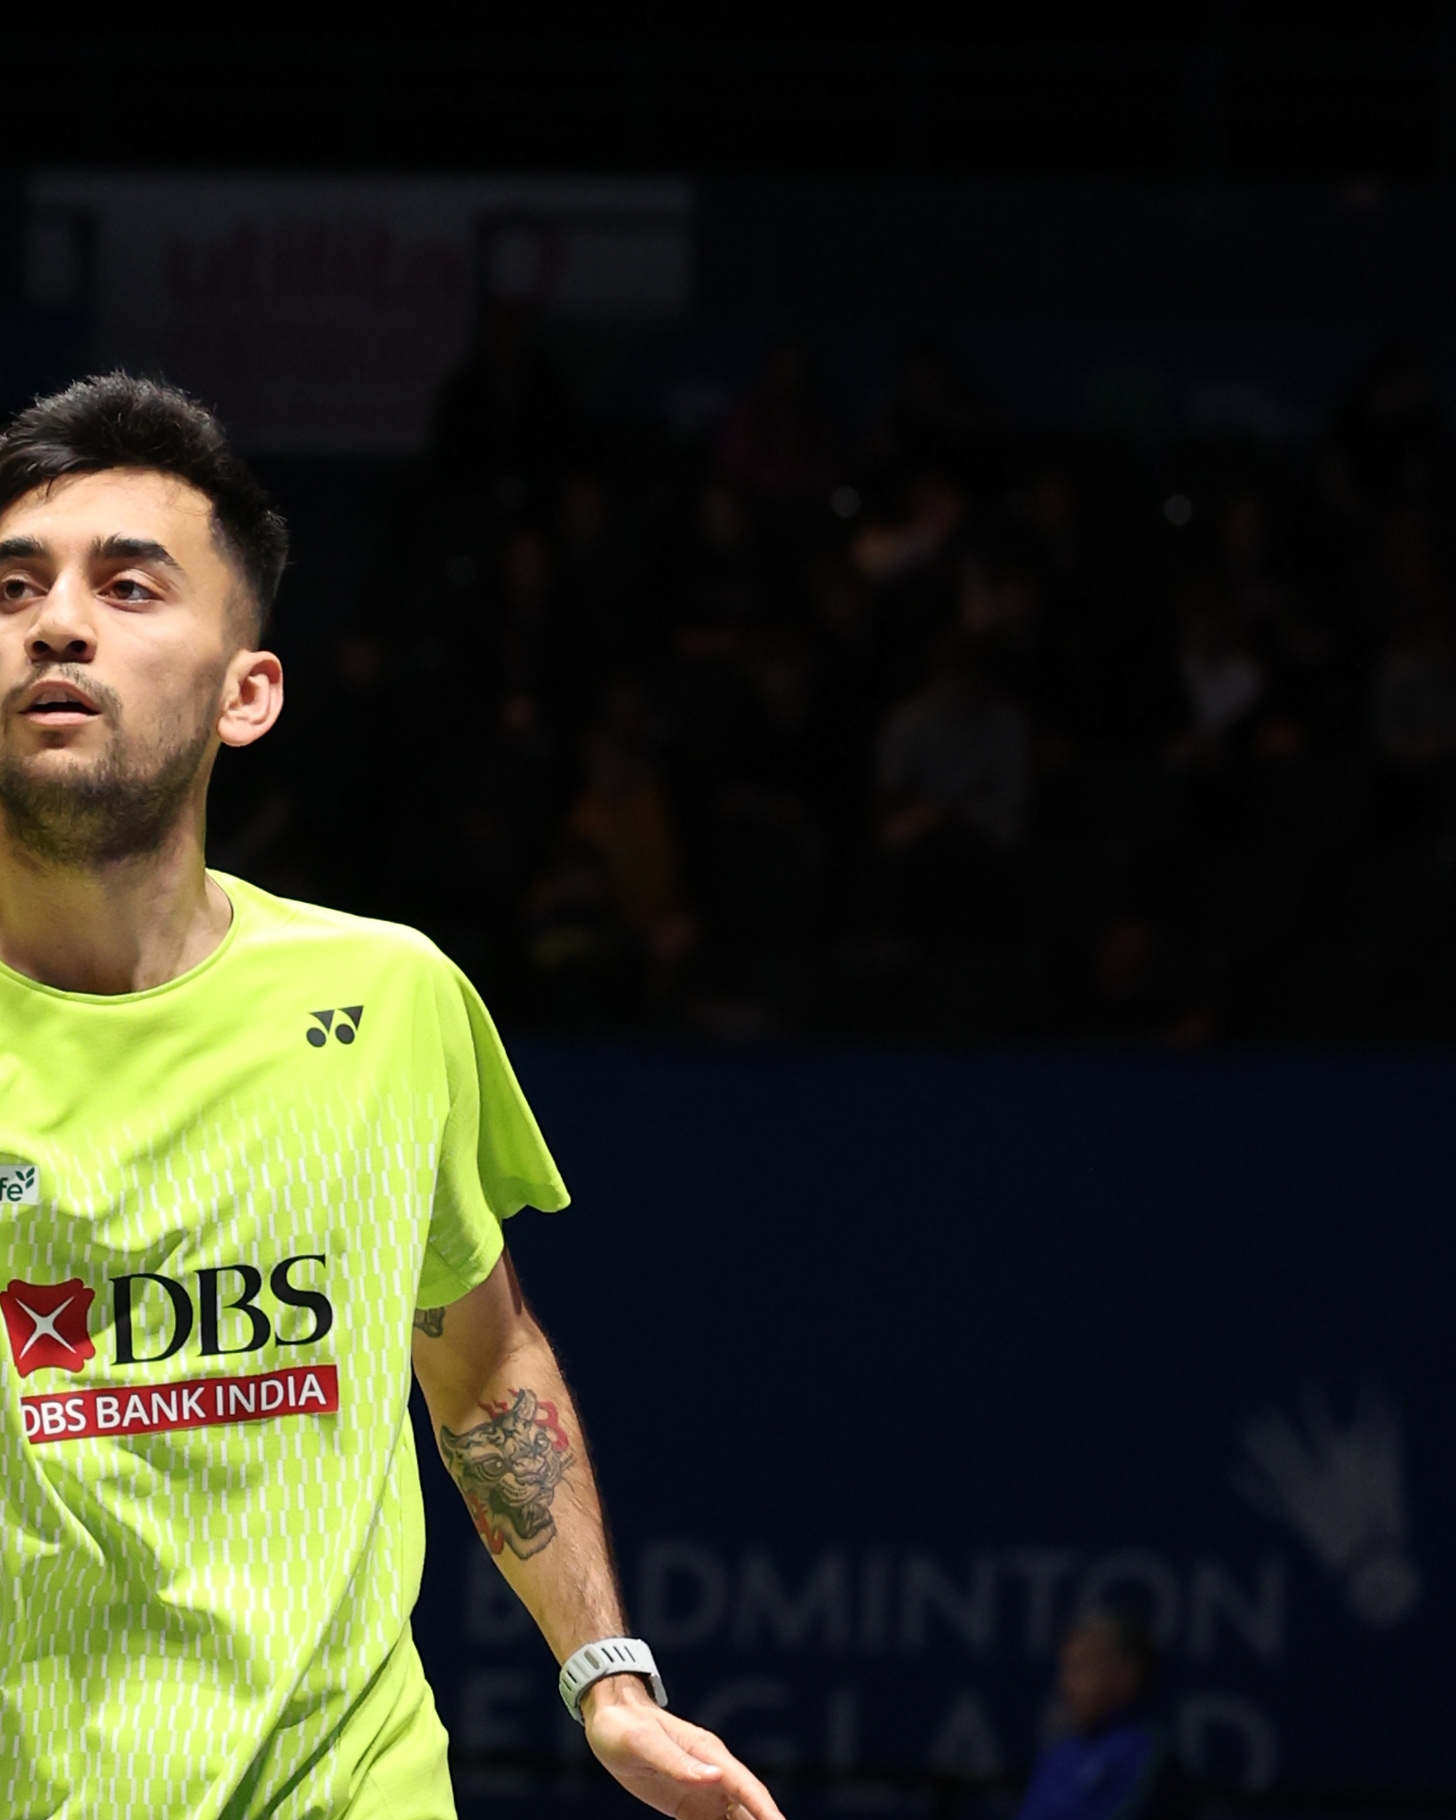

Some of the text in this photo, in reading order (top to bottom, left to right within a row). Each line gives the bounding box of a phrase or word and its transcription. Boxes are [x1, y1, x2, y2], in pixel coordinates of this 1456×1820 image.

[109, 1254, 334, 1366] DBS
[96, 1386, 205, 1430] BANK
[215, 1373, 327, 1416] INDIA
[460, 1537, 1286, 1664] BDMINTON
